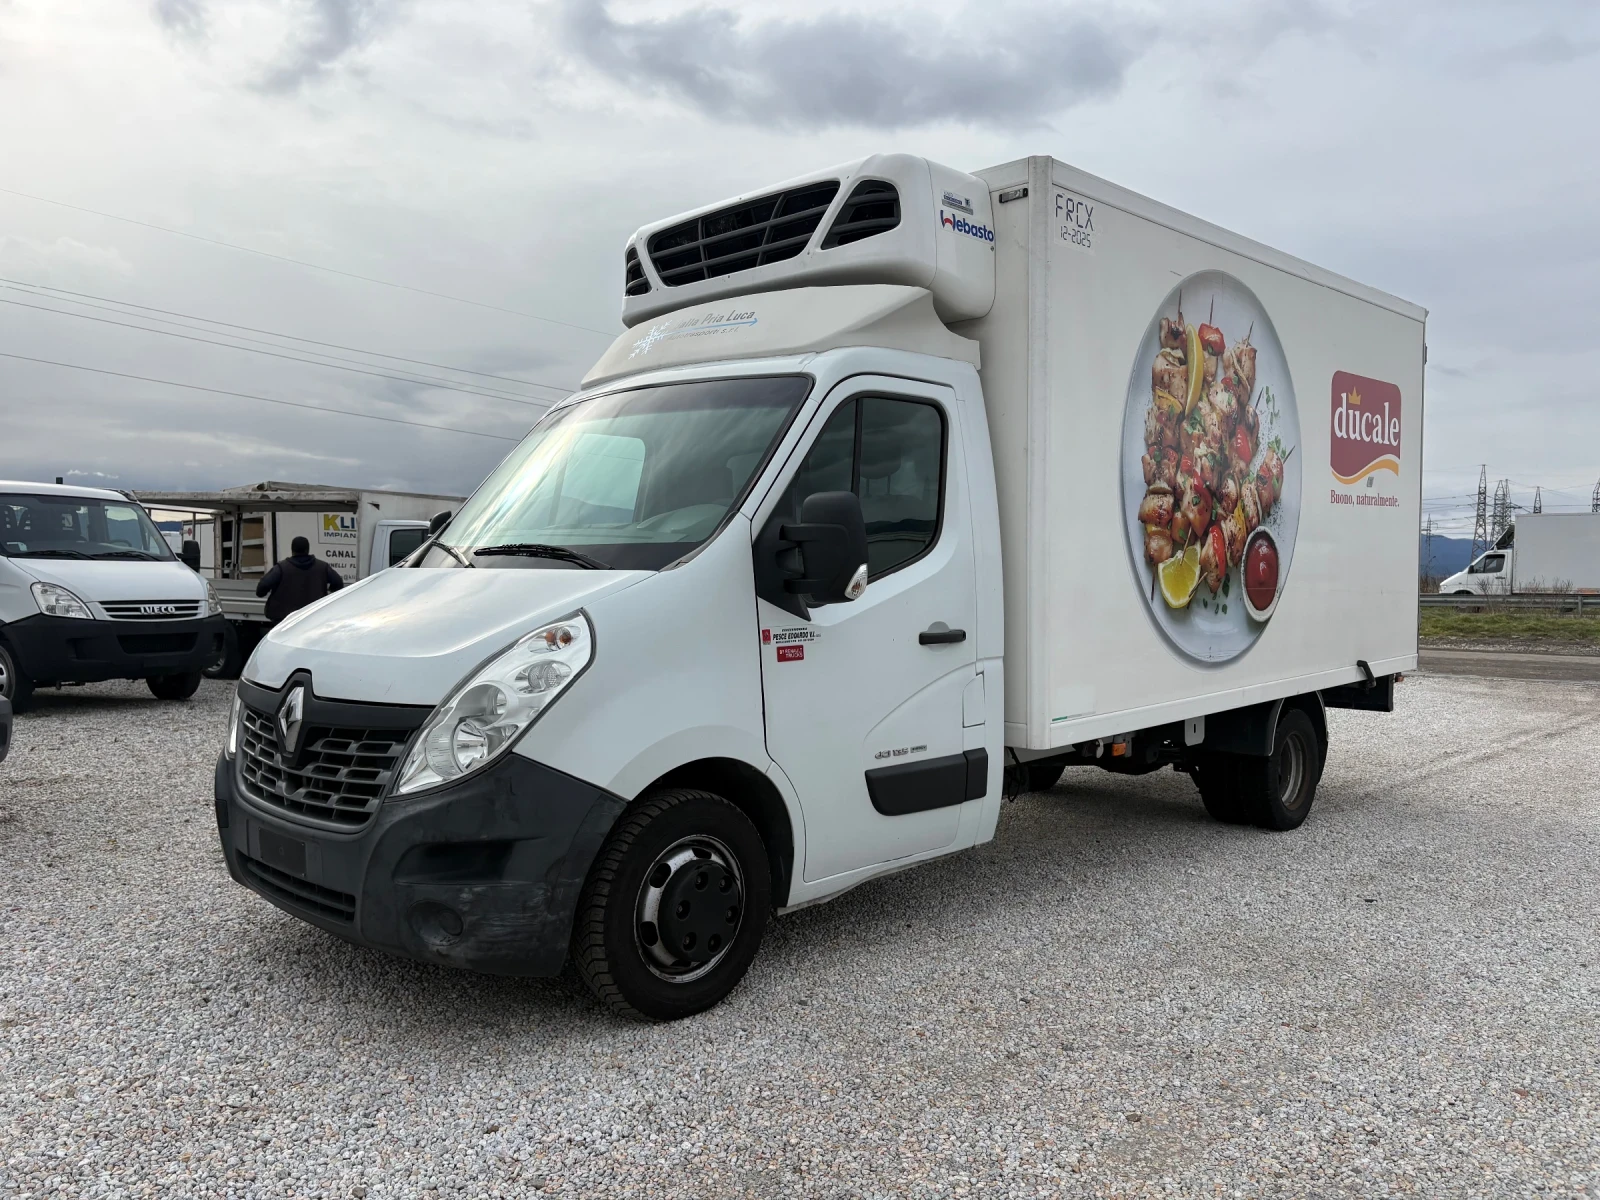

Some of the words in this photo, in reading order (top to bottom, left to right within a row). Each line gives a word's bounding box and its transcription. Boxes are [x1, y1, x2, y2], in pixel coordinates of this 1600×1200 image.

[1055, 193, 1094, 231] FRCX
[940, 209, 994, 242] Webasto
[1060, 226, 1091, 248] 12-2025
[701, 313, 724, 325] Pria
[726, 310, 756, 322] Luca
[1333, 392, 1400, 446] ducale
[1330, 489, 1355, 507] Buono,
[1356, 493, 1400, 507] naturalmente.
[325, 549, 356, 558] CANAL
[140, 605, 176, 614] IVECO
